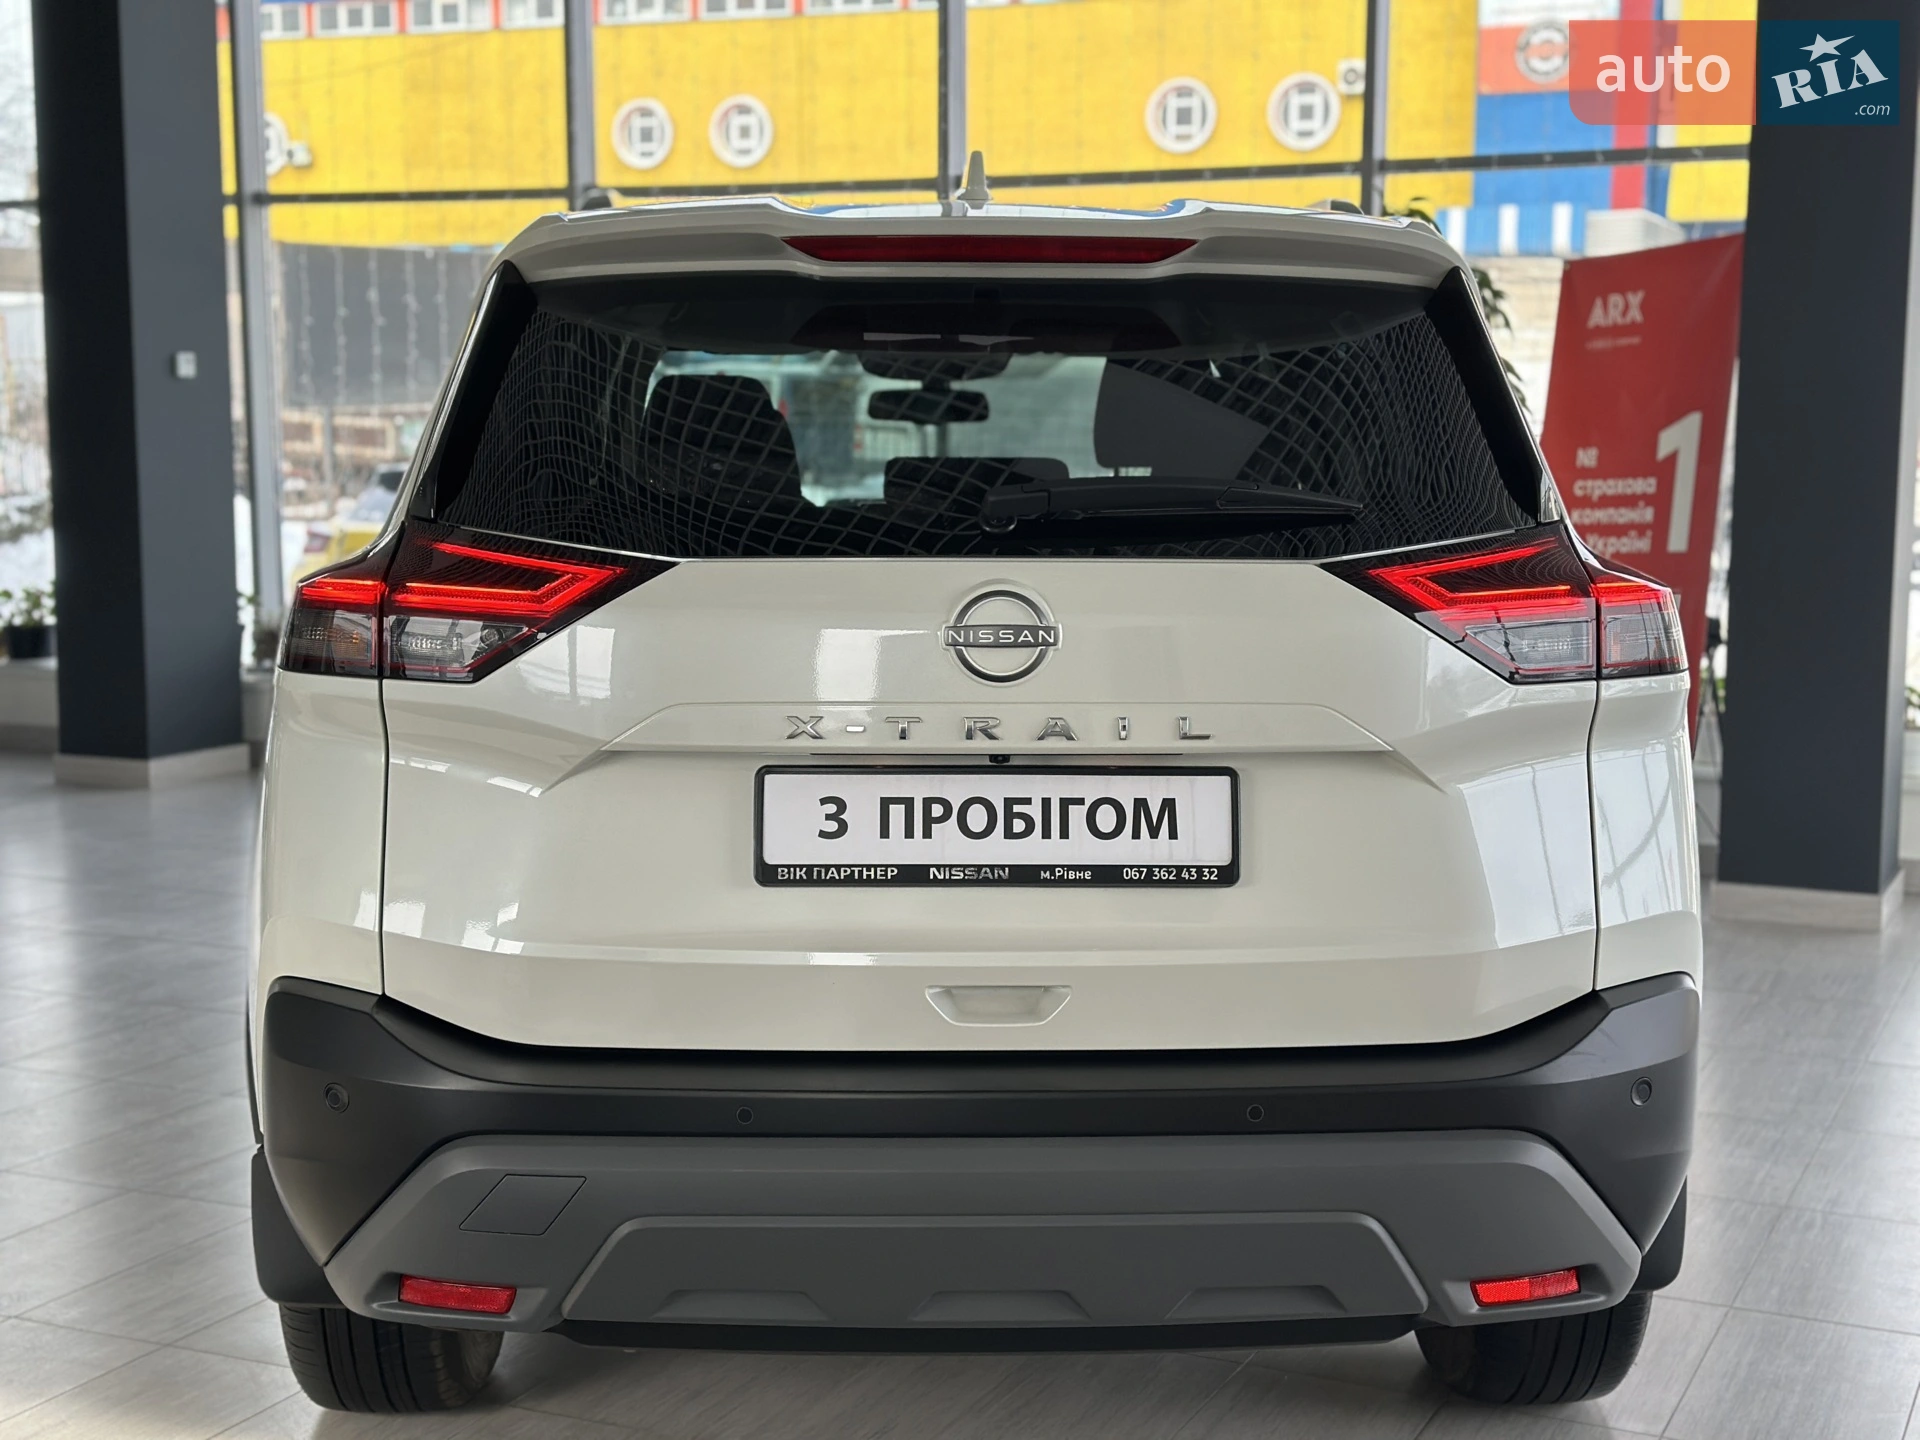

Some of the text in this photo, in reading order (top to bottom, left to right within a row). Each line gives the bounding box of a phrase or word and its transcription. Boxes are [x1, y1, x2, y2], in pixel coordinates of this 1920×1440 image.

[1586, 289, 1646, 329] ARX
[1573, 476, 1657, 502] страхова
[1656, 410, 1703, 553] 1
[1571, 501, 1654, 526] компанія
[948, 629, 1055, 643] NISSAN
[785, 715, 1213, 741] X-TRAIL
[879, 796, 1179, 840] ПРОБІГОМ
[777, 867, 1218, 880] ВІК ПАРТНЕР NISSAN м.Рівне 067 362 43 32
